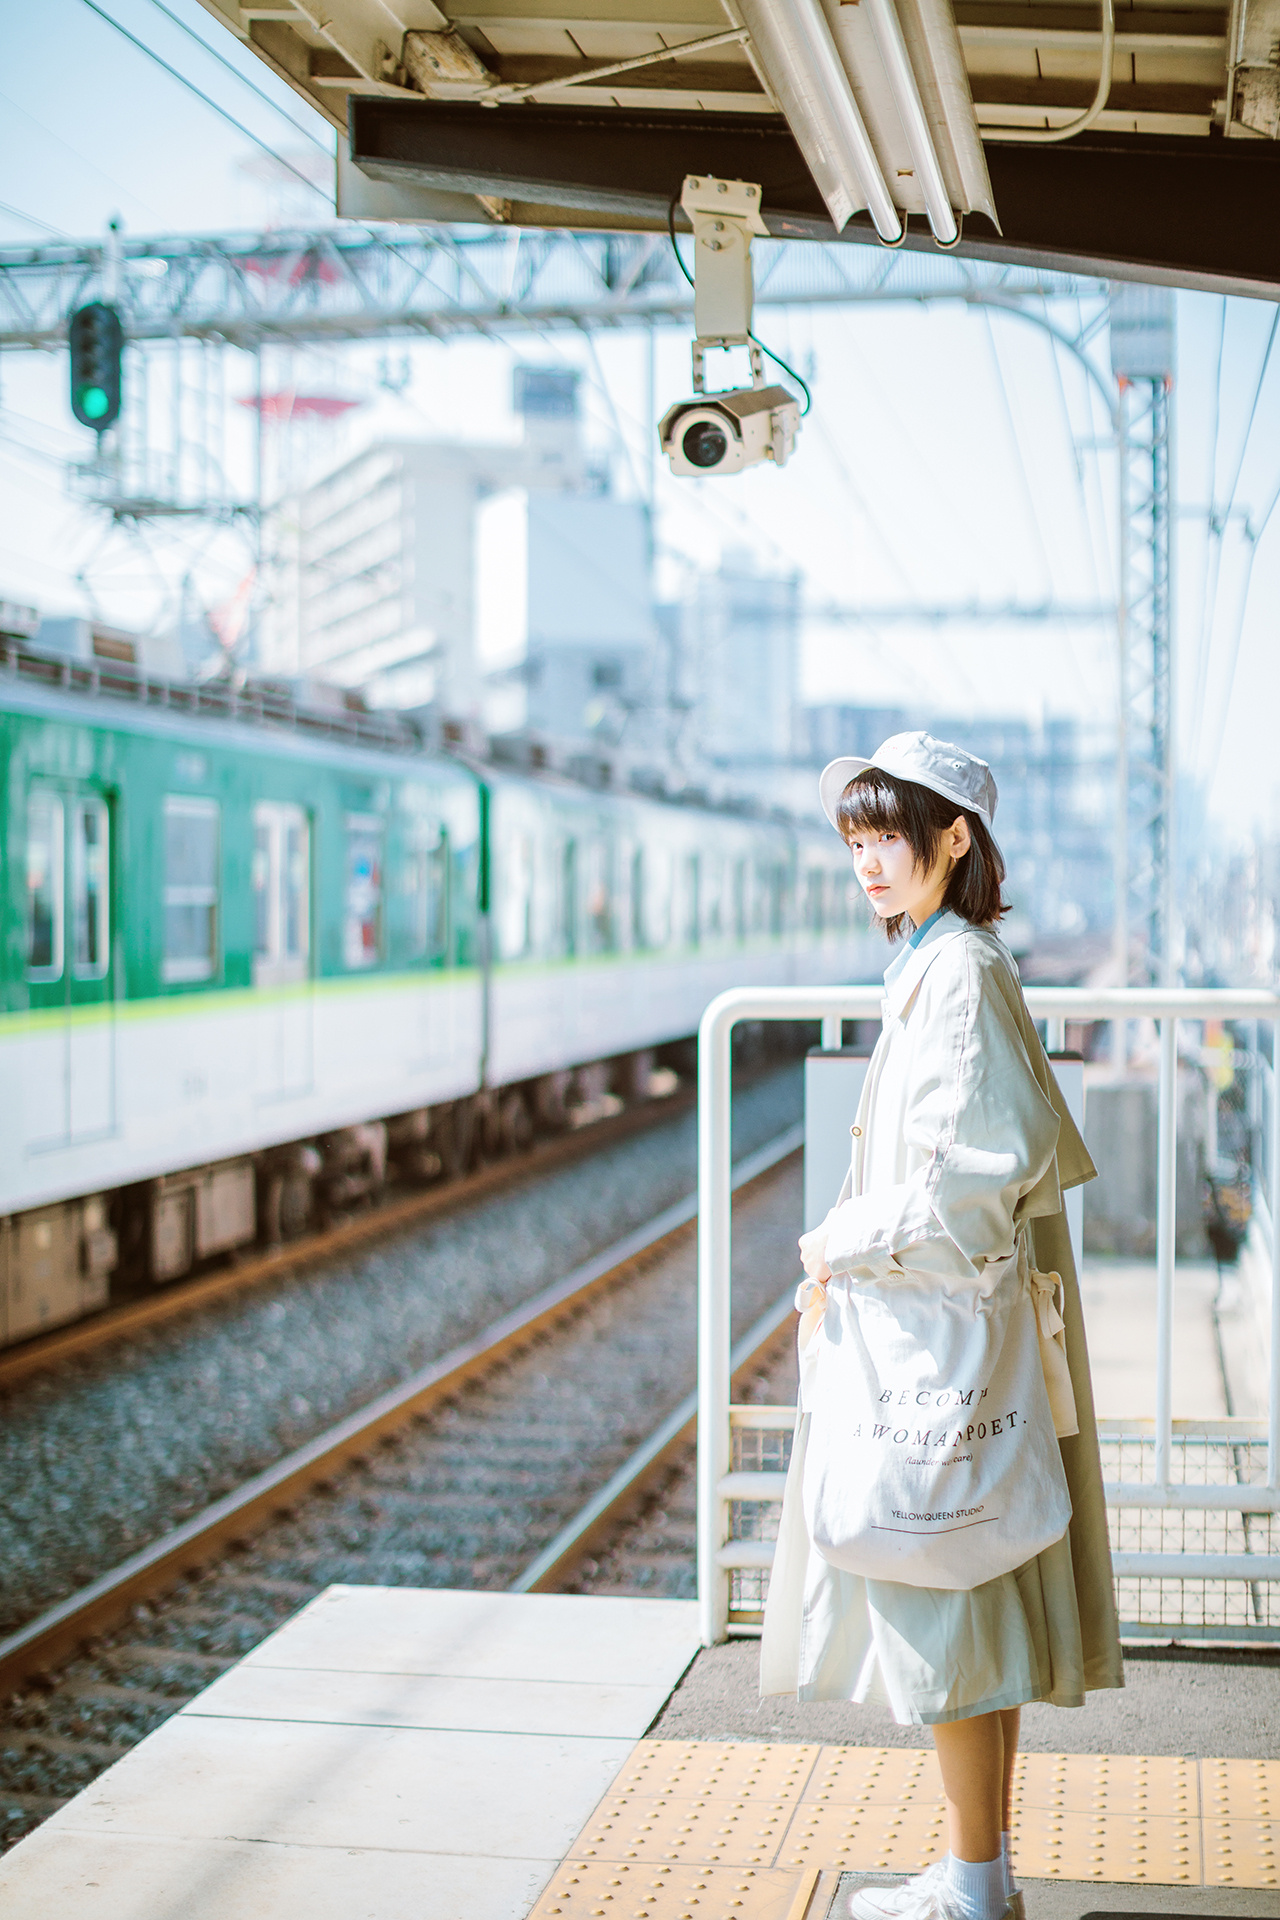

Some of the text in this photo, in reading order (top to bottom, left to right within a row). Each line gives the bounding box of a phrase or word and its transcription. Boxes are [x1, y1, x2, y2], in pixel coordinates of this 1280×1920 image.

[853, 1424, 862, 1437] A
[966, 1411, 1027, 1440] POET.
[953, 1452, 973, 1463] care)
[891, 1505, 985, 1521] YELLOWQUEEN STUDIO
